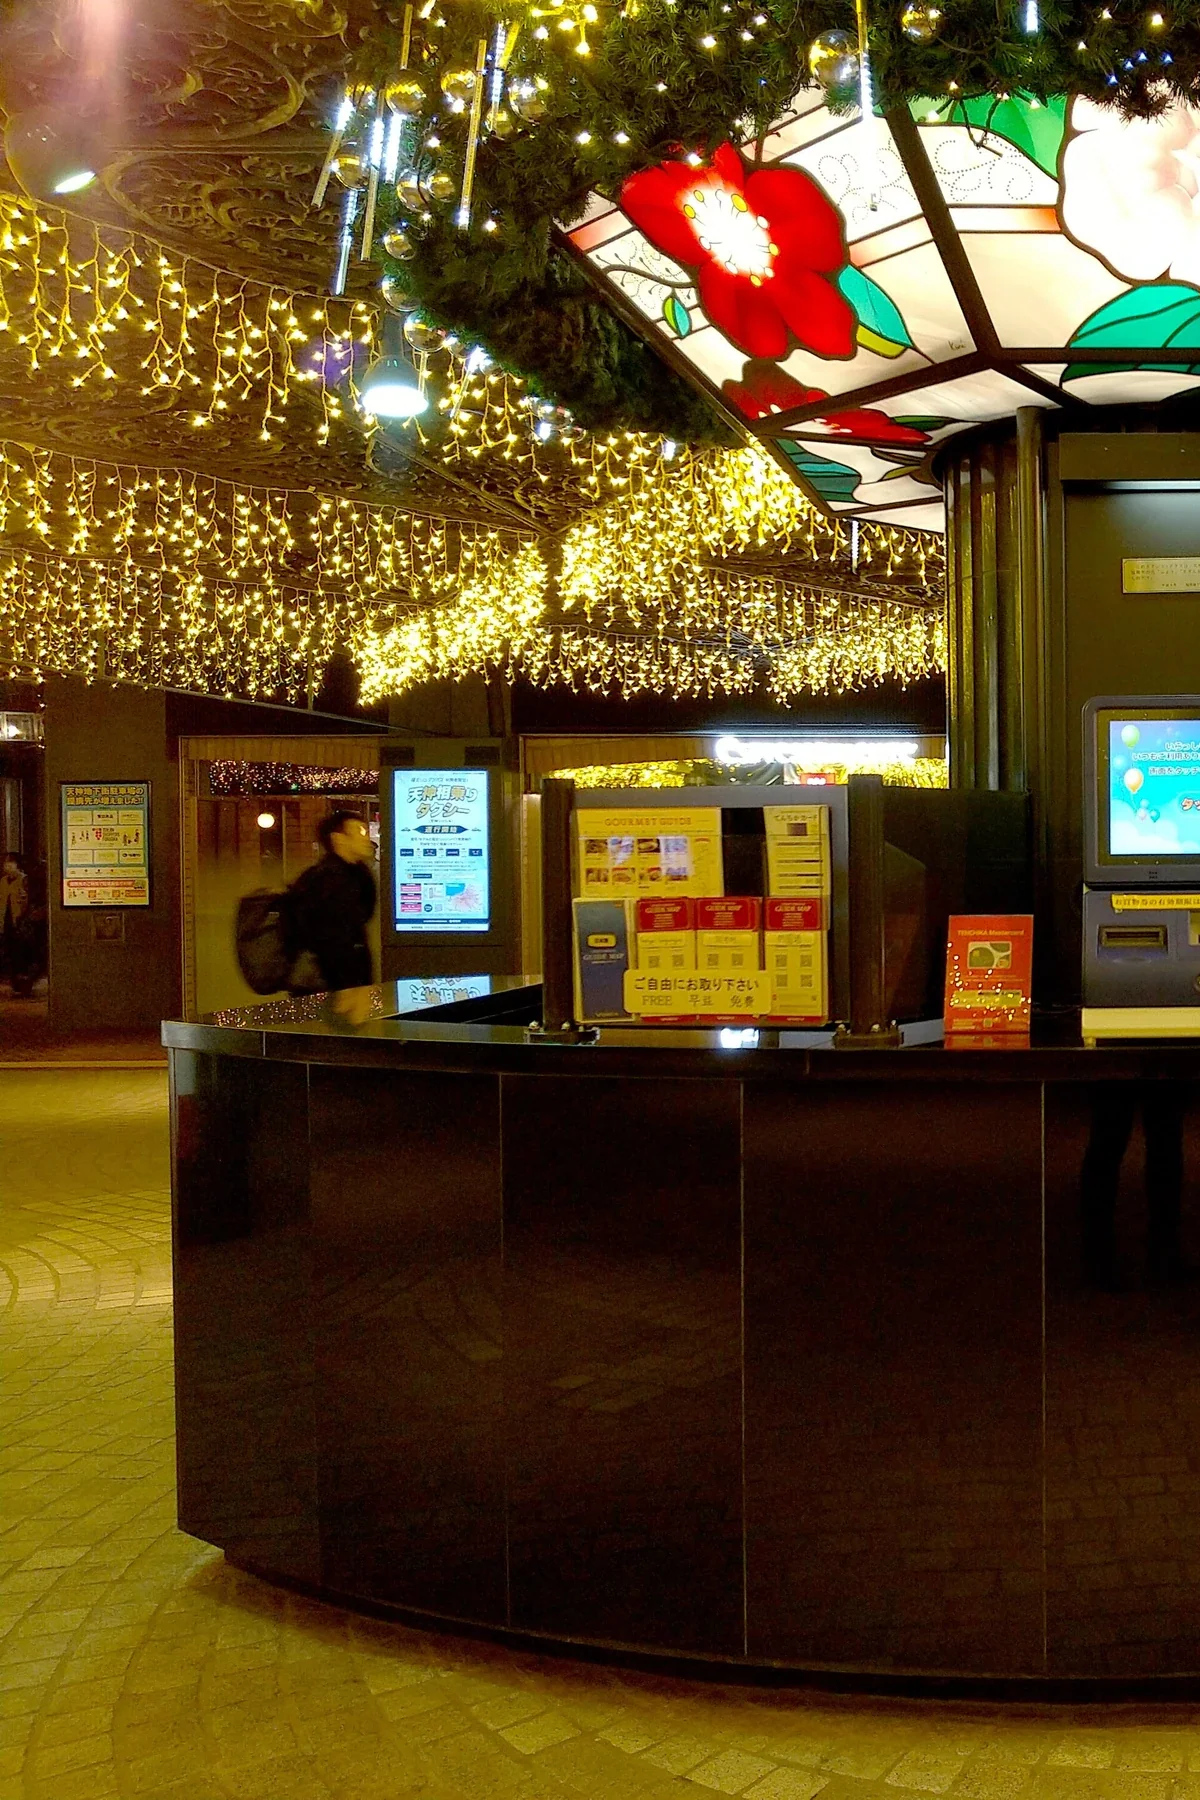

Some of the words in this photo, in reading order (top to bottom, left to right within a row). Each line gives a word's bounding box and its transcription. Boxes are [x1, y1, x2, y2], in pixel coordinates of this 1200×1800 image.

[407, 784, 478, 803] 天神相乗り
[416, 802, 470, 819] タクシー
[605, 818, 657, 826] GOURMET
[660, 817, 692, 825] GUIDE
[634, 977, 760, 991] ご自由にお取り下さい
[642, 995, 673, 1006] FREE
